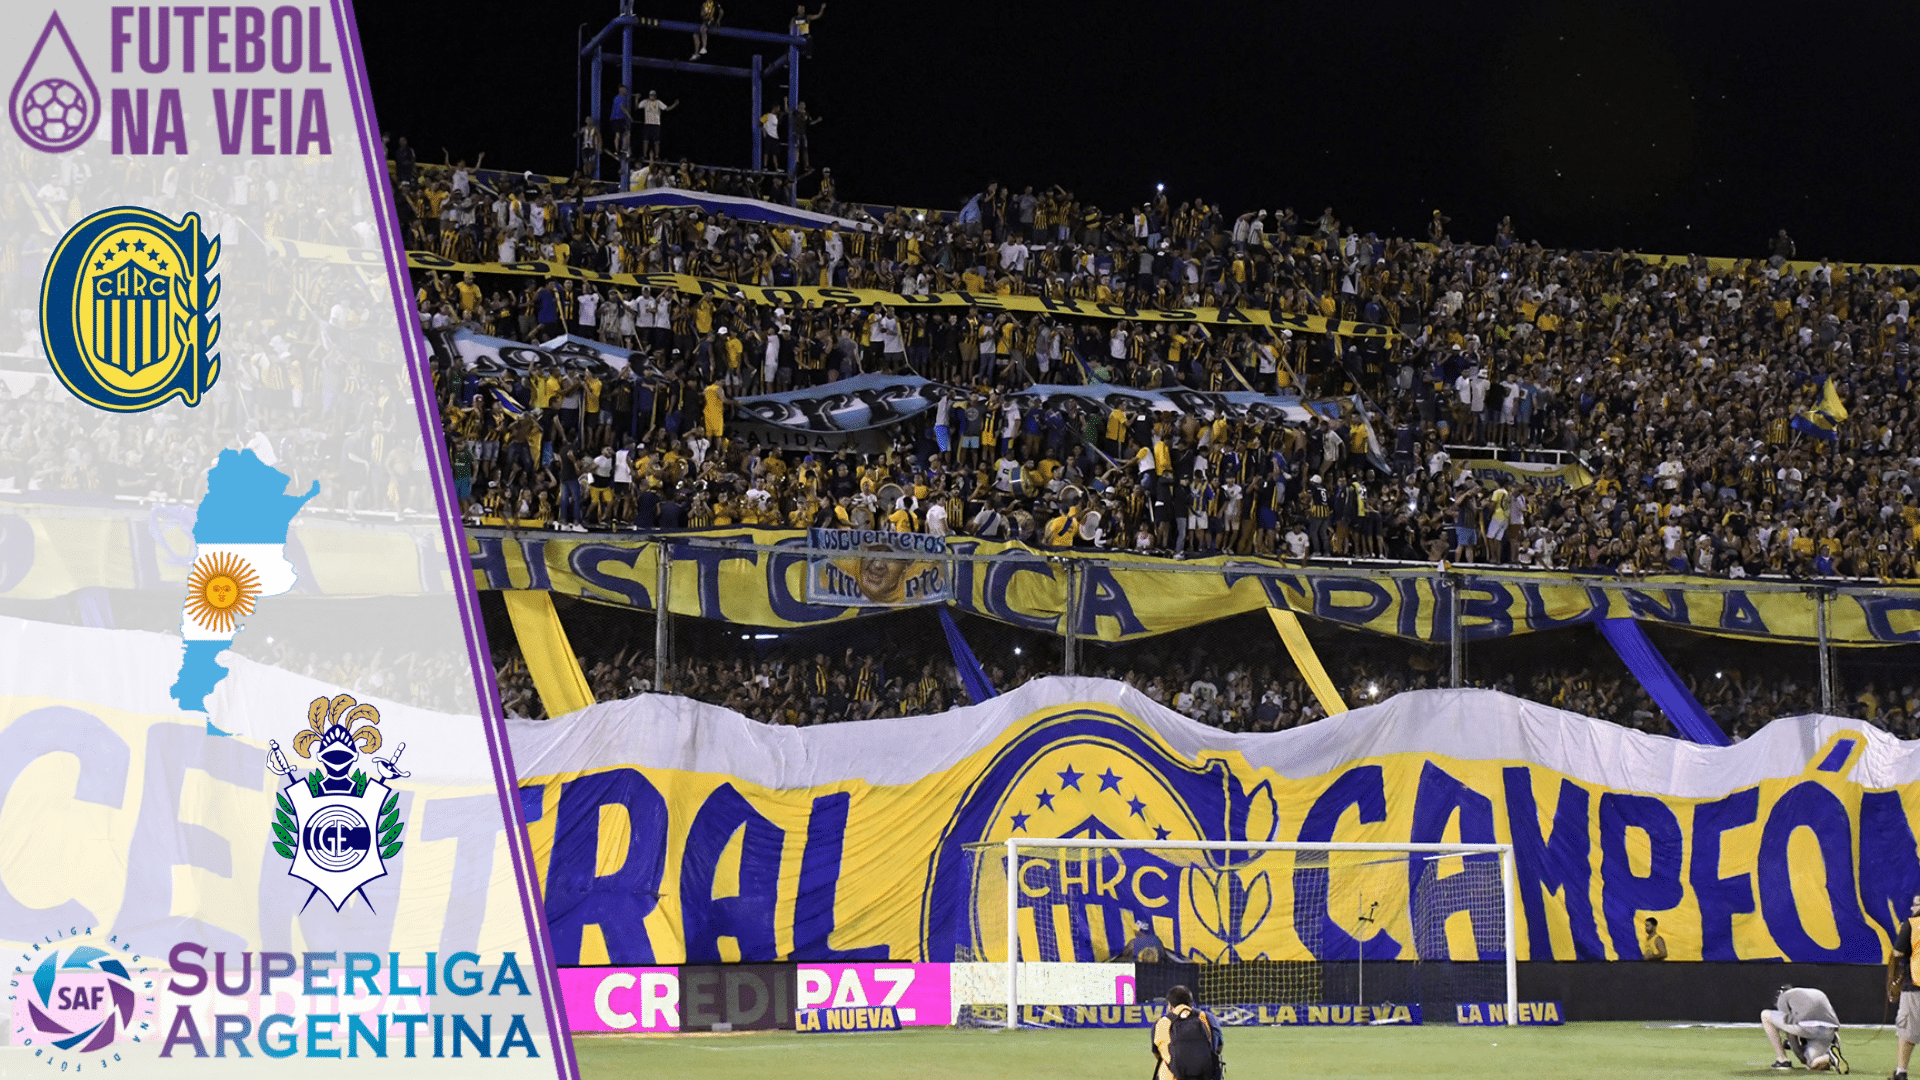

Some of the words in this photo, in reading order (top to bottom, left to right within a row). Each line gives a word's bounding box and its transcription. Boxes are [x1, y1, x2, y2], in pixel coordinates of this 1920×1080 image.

[796, 1010, 823, 1031] LA
[827, 1007, 896, 1030] NUEVA
[1076, 1005, 1168, 1024] NUEV
[1258, 1006, 1298, 1024] LA
[1307, 1005, 1414, 1024] NUEVA
[1457, 1005, 1482, 1024] LA
